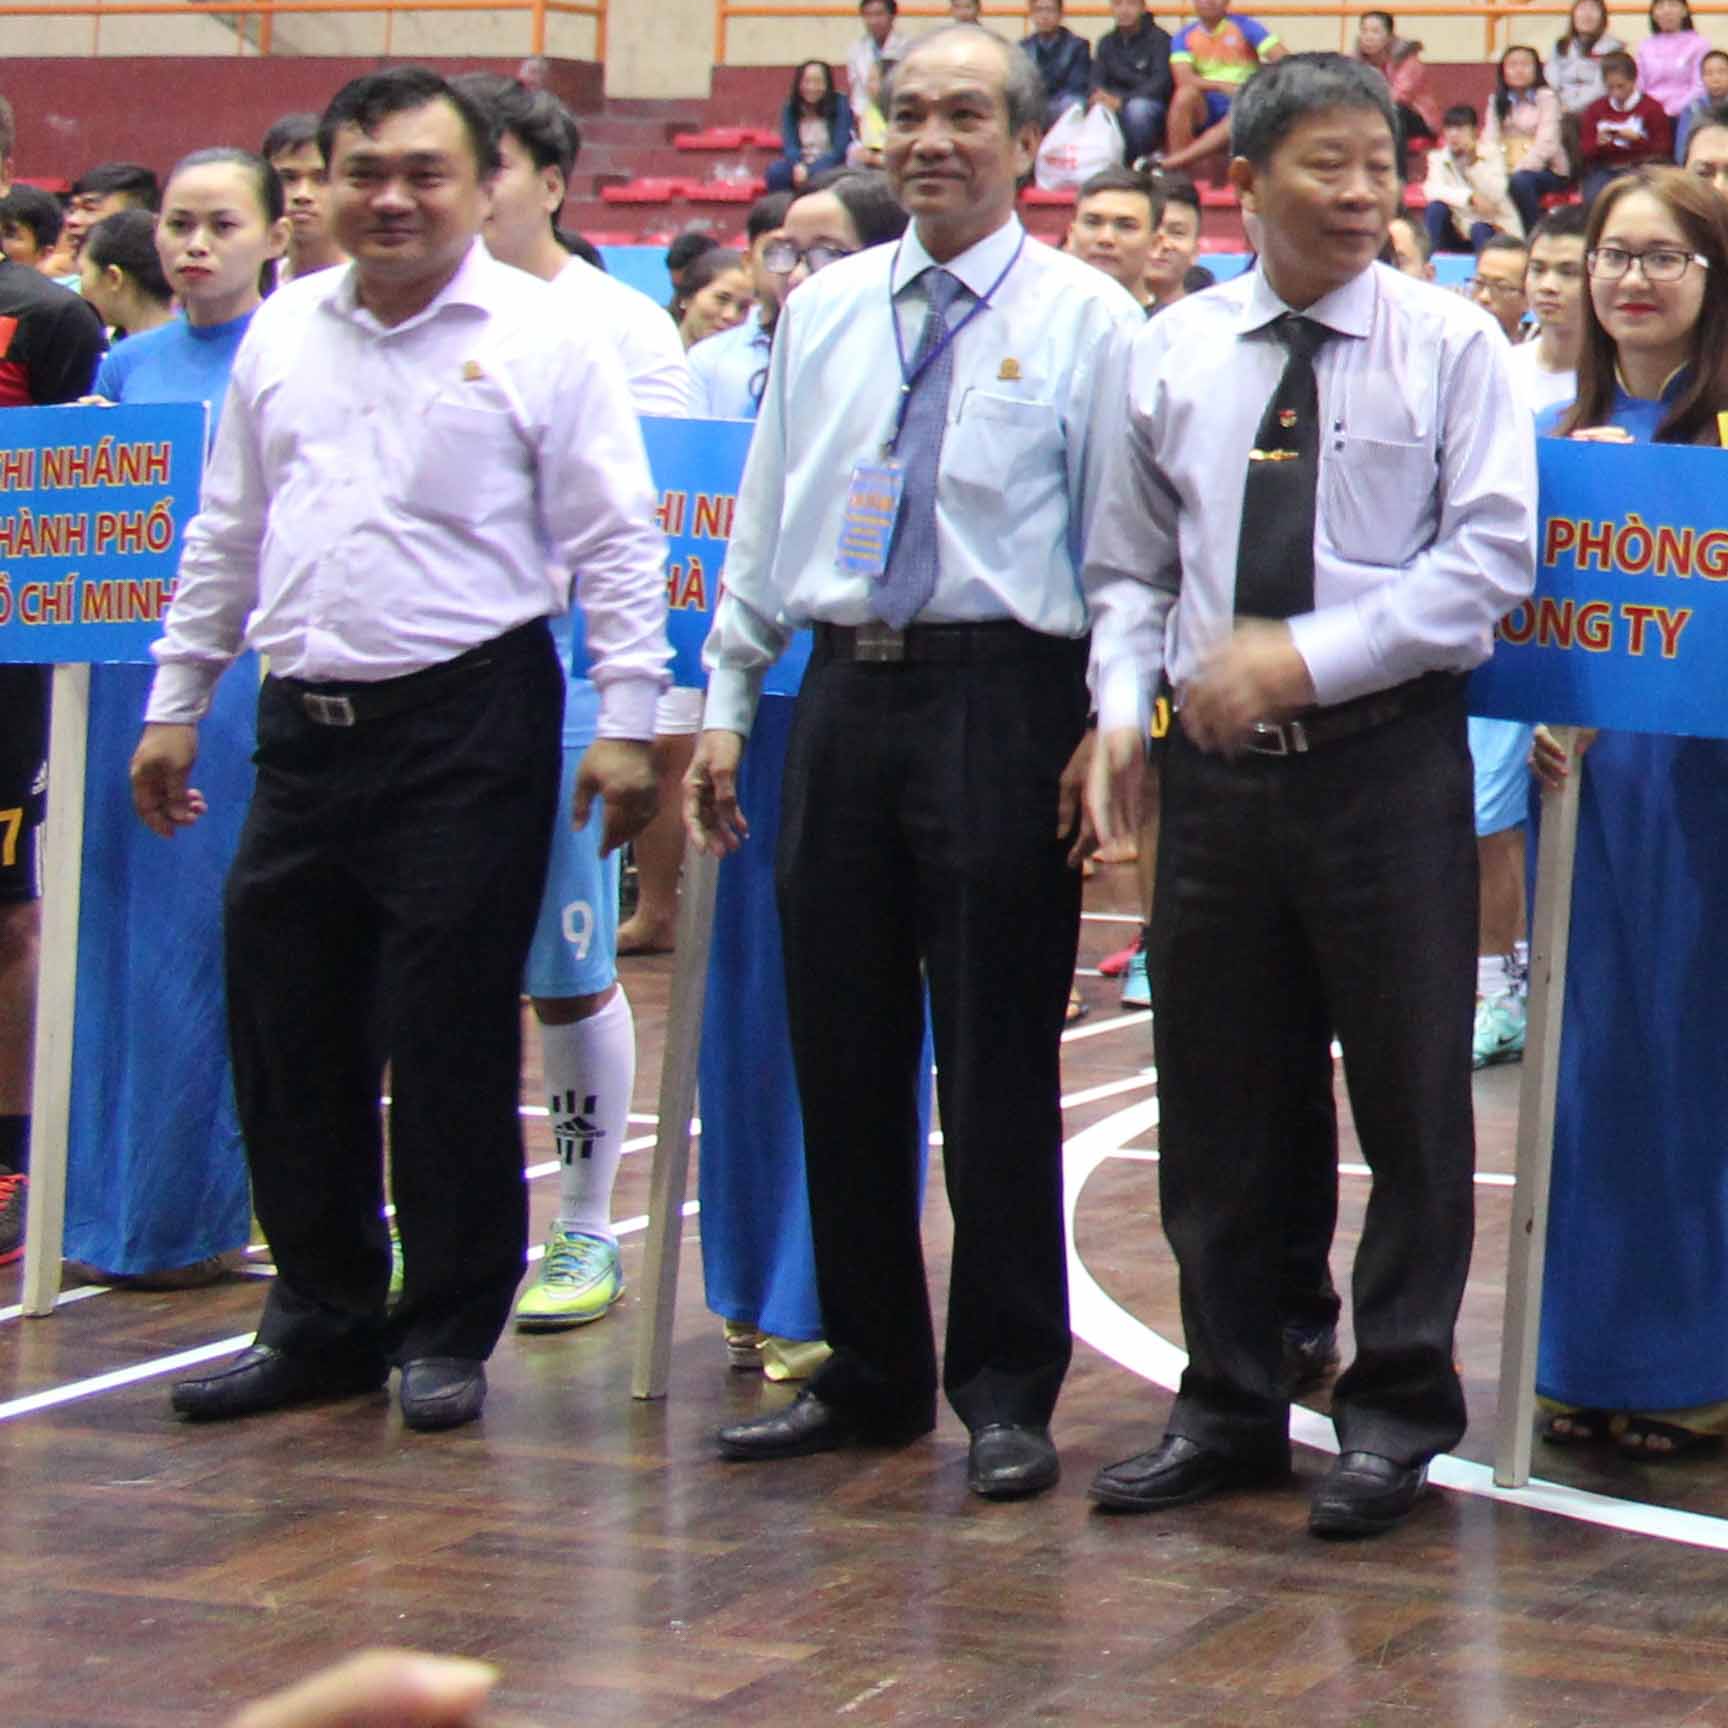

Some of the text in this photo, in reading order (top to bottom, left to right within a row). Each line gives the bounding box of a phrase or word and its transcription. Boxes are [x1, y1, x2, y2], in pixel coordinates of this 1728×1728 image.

[0, 436, 172, 492] HI NHÁNH
[0, 496, 174, 558] HÀNH PHỐ
[655, 490, 687, 537] HI
[19, 572, 78, 625] CHÍ
[81, 580, 180, 623] MINH
[1622, 603, 1693, 659] TY
[562, 900, 593, 961] 9
